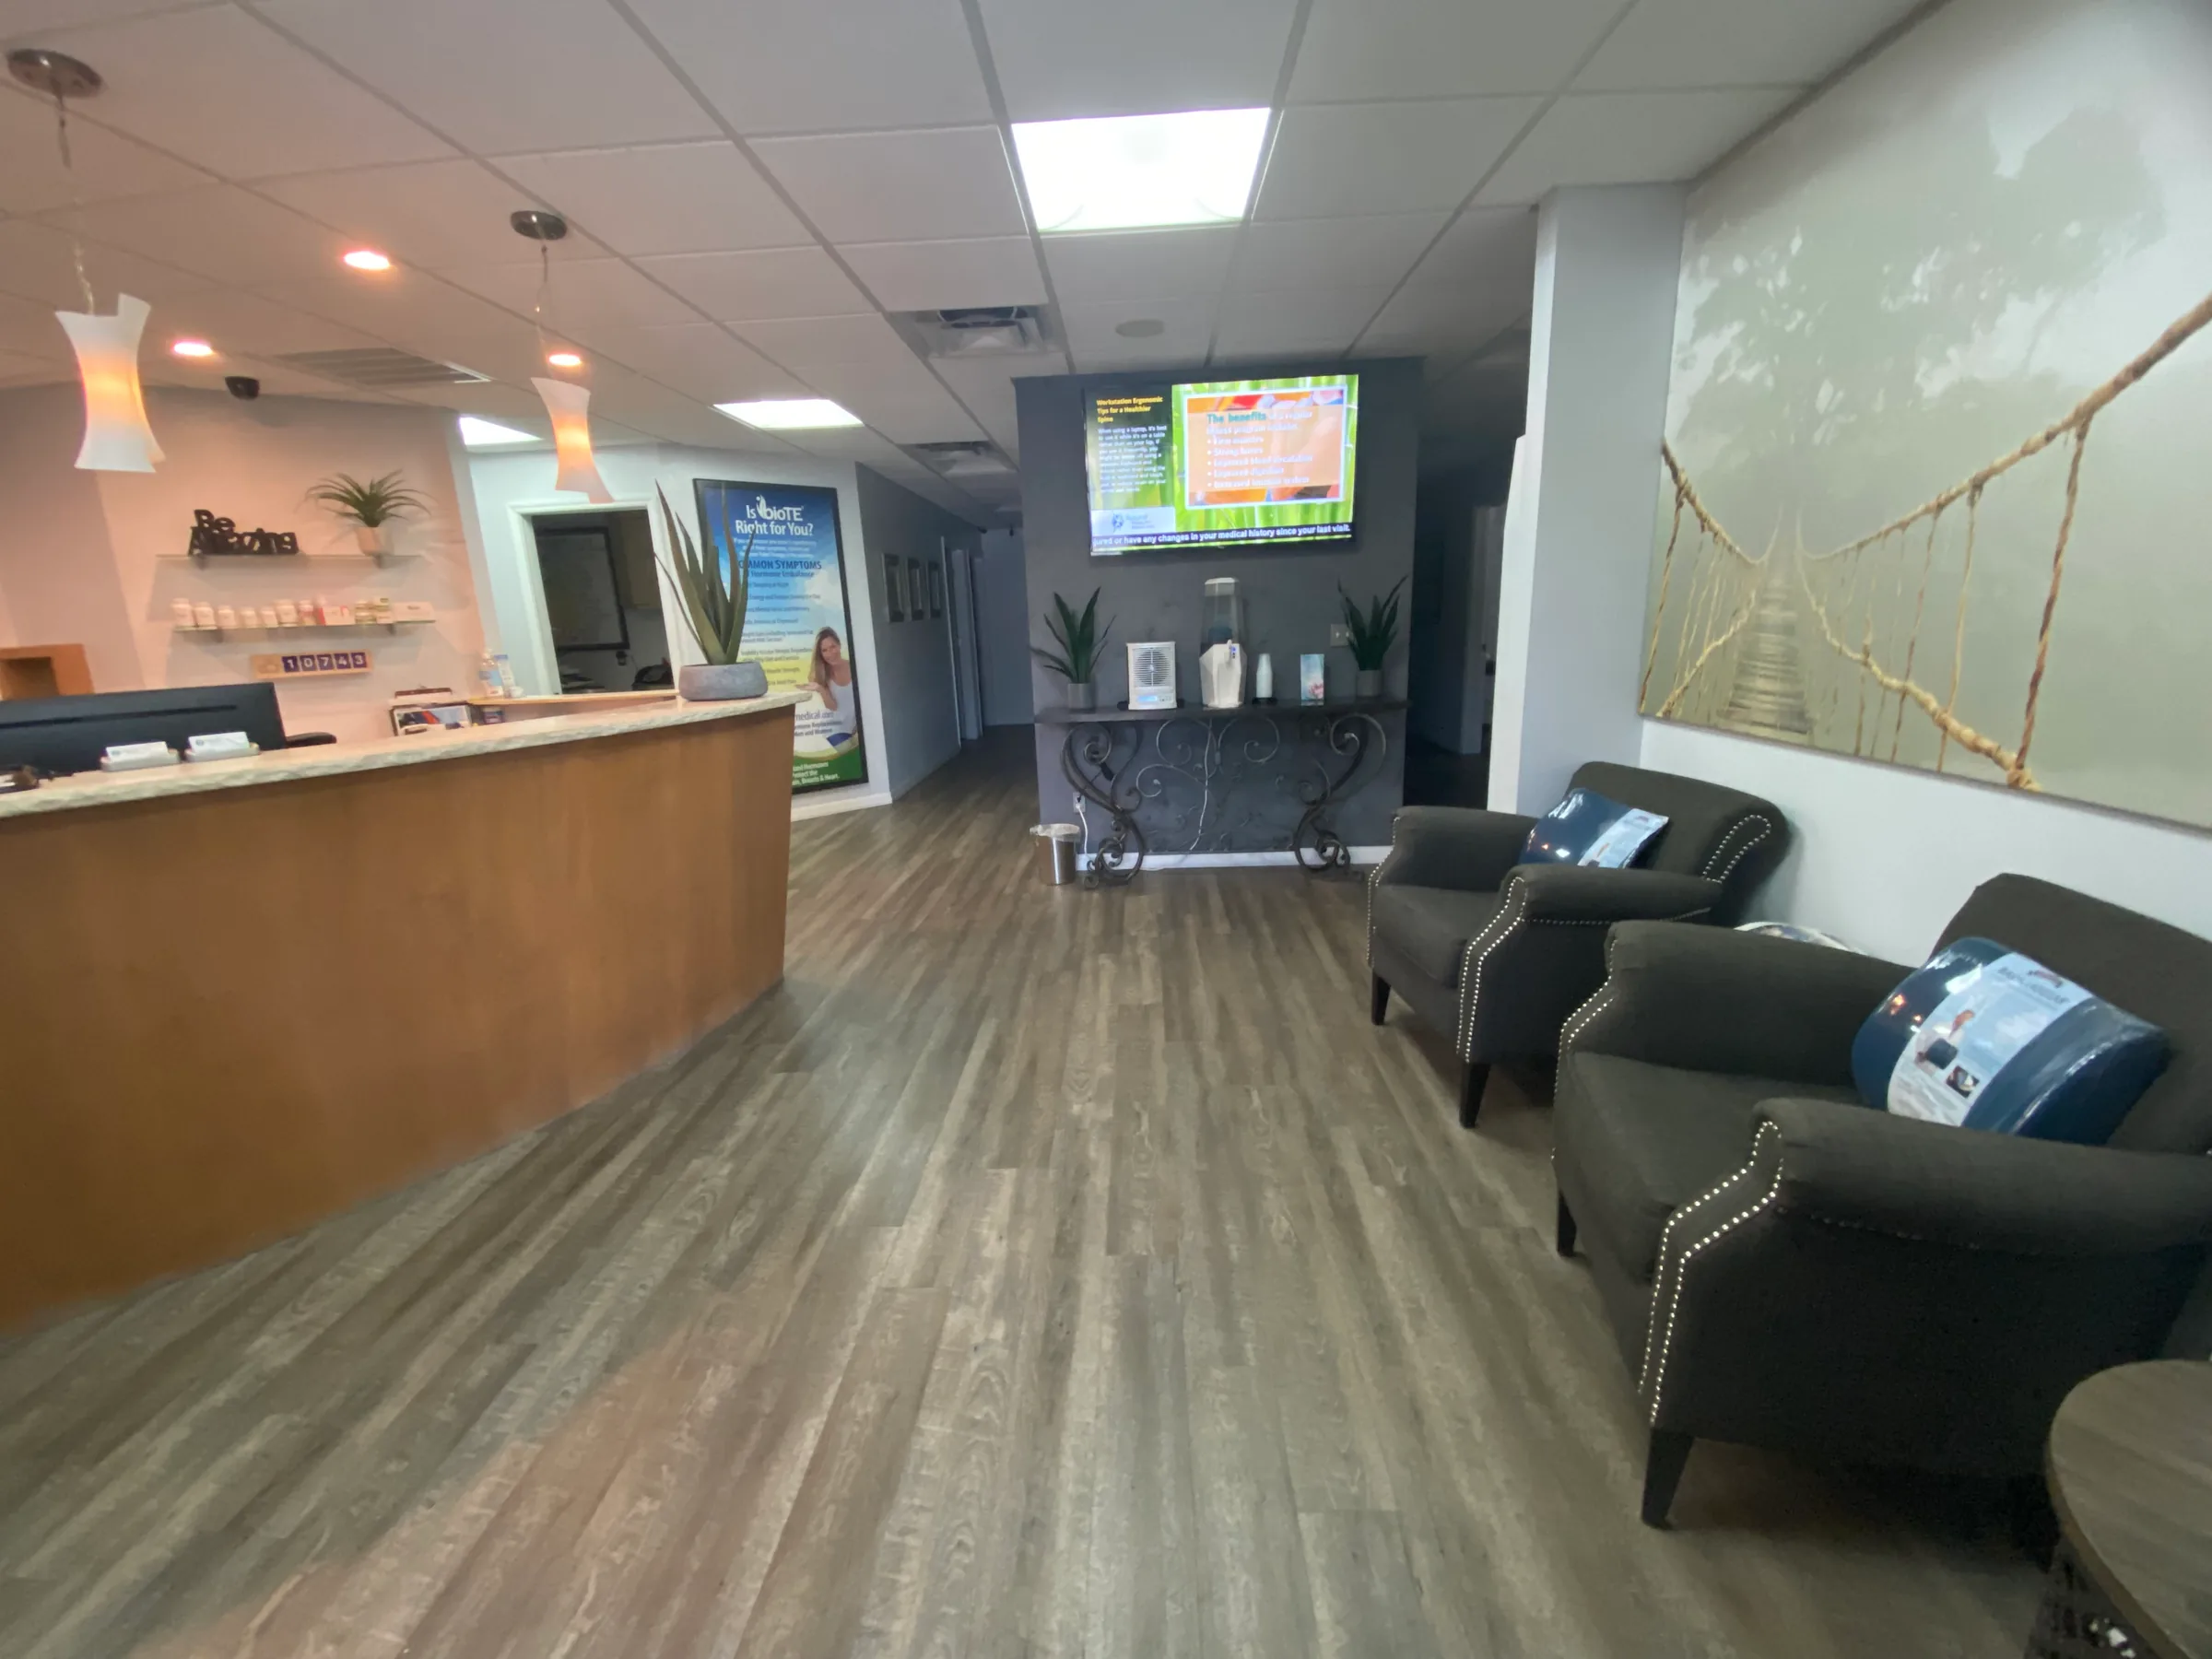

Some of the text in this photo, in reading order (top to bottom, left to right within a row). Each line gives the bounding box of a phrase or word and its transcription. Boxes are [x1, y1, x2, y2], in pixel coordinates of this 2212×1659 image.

[1133, 396, 1163, 405] Ergonomic
[1207, 413, 1224, 423] The
[1229, 411, 1266, 422] benefits
[746, 505, 756, 519] Is
[194, 509, 236, 534] Be
[735, 520, 813, 536] Right for You?
[1124, 535, 1142, 544] have
[1143, 535, 1157, 544] any
[1158, 534, 1189, 544] changes
[1199, 533, 1217, 542] your
[1218, 530, 1247, 539] medical
[1248, 529, 1275, 538] history
[1276, 527, 1297, 535] since
[1298, 525, 1316, 536] your
[1316, 524, 1331, 533] last
[1333, 524, 1350, 533] visit.
[775, 559, 822, 570] SYMPTOMS
